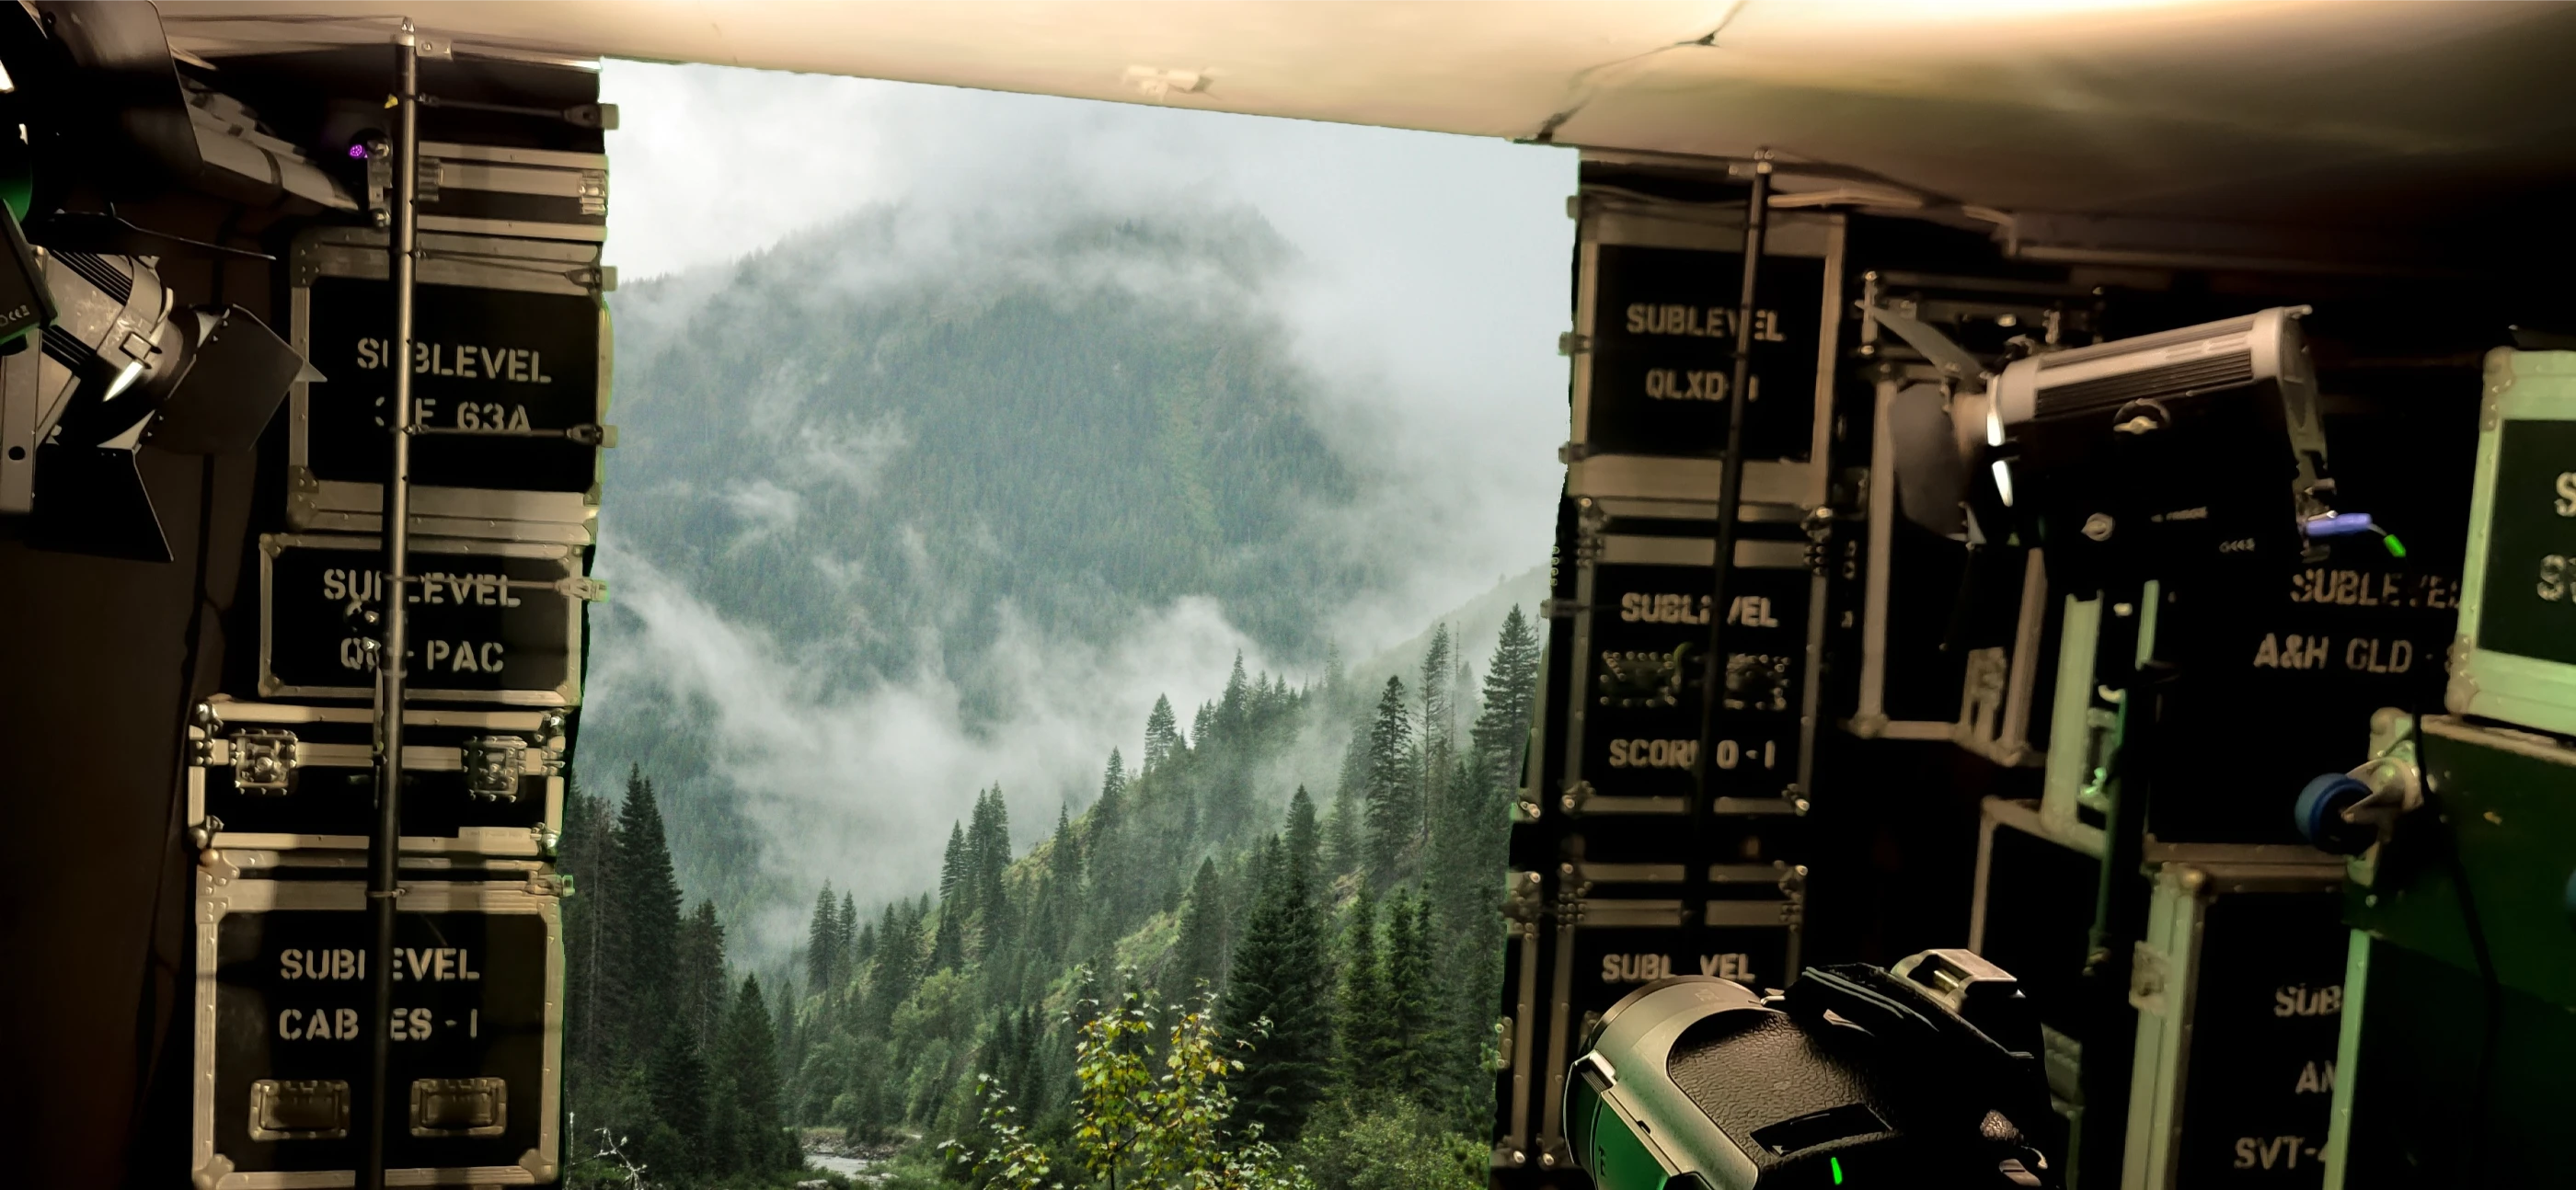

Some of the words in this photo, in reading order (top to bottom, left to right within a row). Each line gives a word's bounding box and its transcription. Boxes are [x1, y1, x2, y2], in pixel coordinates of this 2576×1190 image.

[324, 568, 522, 607] SUEVEL
[427, 640, 504, 672] PAC
[2253, 632, 2329, 669] A&H
[1602, 953, 1755, 984] SUBLVEL
[279, 1008, 432, 1041] CABES
[2234, 1135, 2329, 1170] SVT-
